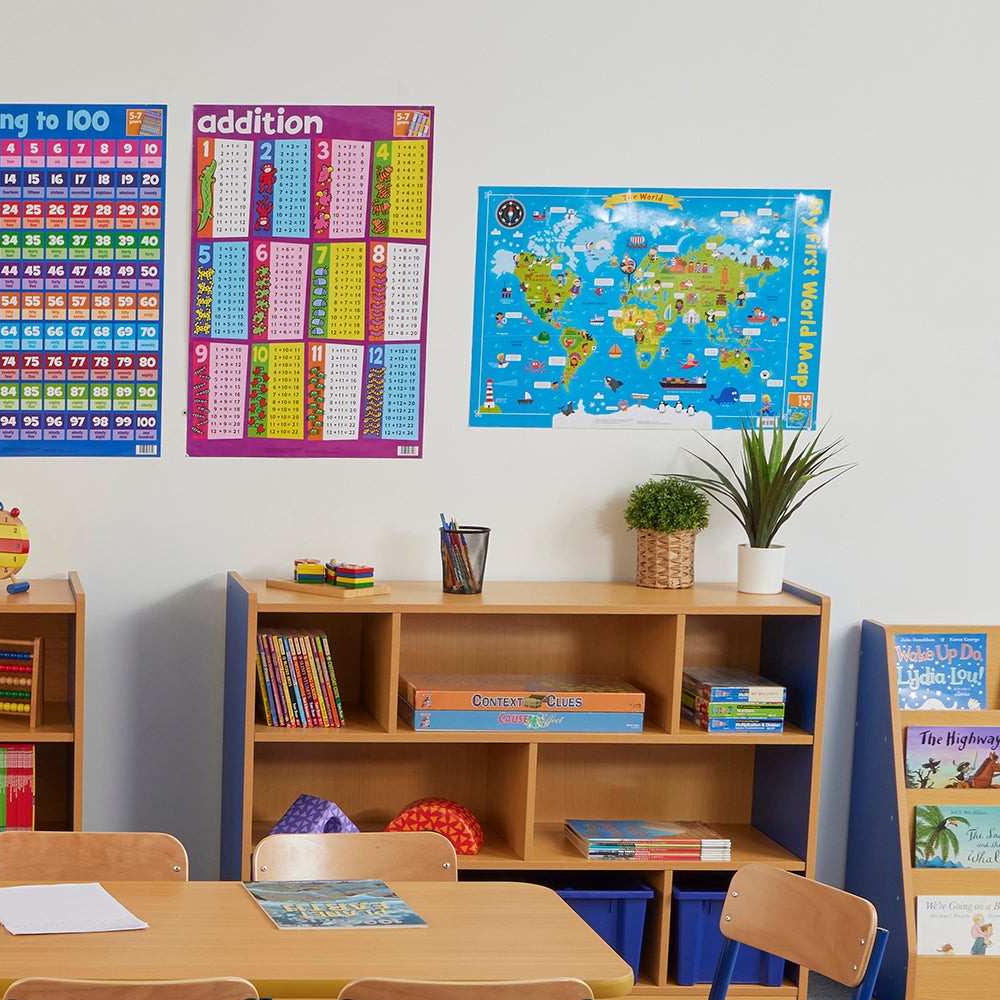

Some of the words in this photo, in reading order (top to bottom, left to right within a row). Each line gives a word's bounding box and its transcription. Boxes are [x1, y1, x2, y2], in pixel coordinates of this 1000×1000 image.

[37, 111, 59, 131] to
[67, 110, 110, 131] 100
[129, 112, 142, 120] 5-7
[197, 107, 323, 135] addition
[6, 143, 16, 154] 4
[30, 142, 39, 154] 5
[53, 143, 63, 154] 6
[77, 143, 86, 154] 7
[100, 143, 109, 154] 8
[123, 143, 133, 154] 9
[144, 143, 158, 155] 10
[203, 140, 209, 157] 1
[260, 142, 272, 160] 2
[317, 141, 329, 160] 3
[376, 144, 389, 160] 4
[4, 173, 17, 184] 14
[27, 173, 40, 185] 15
[51, 173, 64, 185] 16
[74, 174, 87, 185] 17
[98, 173, 111, 185] 18
[121, 173, 134, 185] 19
[142, 173, 160, 186] 20
[640, 193, 663, 201] World
[2, 203, 19, 215] 24
[25, 204, 42, 216] 25
[48, 204, 66, 216] 26
[72, 204, 89, 216] 27
[95, 204, 112, 216] 28
[118, 204, 136, 216] 29
[141, 204, 159, 216] 30
[800, 198, 824, 228] My
[198, 245, 211, 263] 5
[256, 244, 268, 262] 6
[317, 246, 328, 264] 7
[373, 245, 385, 263] 8
[803, 234, 822, 276] First
[800, 281, 818, 337] World
[195, 344, 208, 363] 9
[252, 346, 268, 363] 10
[311, 345, 322, 362] 11
[369, 347, 383, 364] 12
[790, 342, 814, 387] Map
[802, 395, 811, 407] 5+
[0, 415, 17, 427] 94
[23, 416, 40, 427] 95
[45, 416, 63, 427] 96
[69, 416, 86, 427] 97
[92, 416, 109, 427] 98
[115, 416, 132, 427] 99
[136, 416, 157, 428] 100
[895, 645, 934, 663] Wake
[935, 644, 958, 665] Up
[896, 666, 946, 690] Lydia
[950, 666, 985, 687] Lou!
[471, 694, 523, 708] CONTEXT
[546, 694, 583, 708] CLUES
[498, 713, 529, 724] CAUSE
[919, 730, 943, 746] The
[946, 731, 1000, 751] Highway
[966, 827, 984, 841] The
[280, 901, 390, 912] EARTH
[300, 908, 389, 917] PLANET
[926, 901, 946, 910] We're
[949, 901, 972, 912] Going
